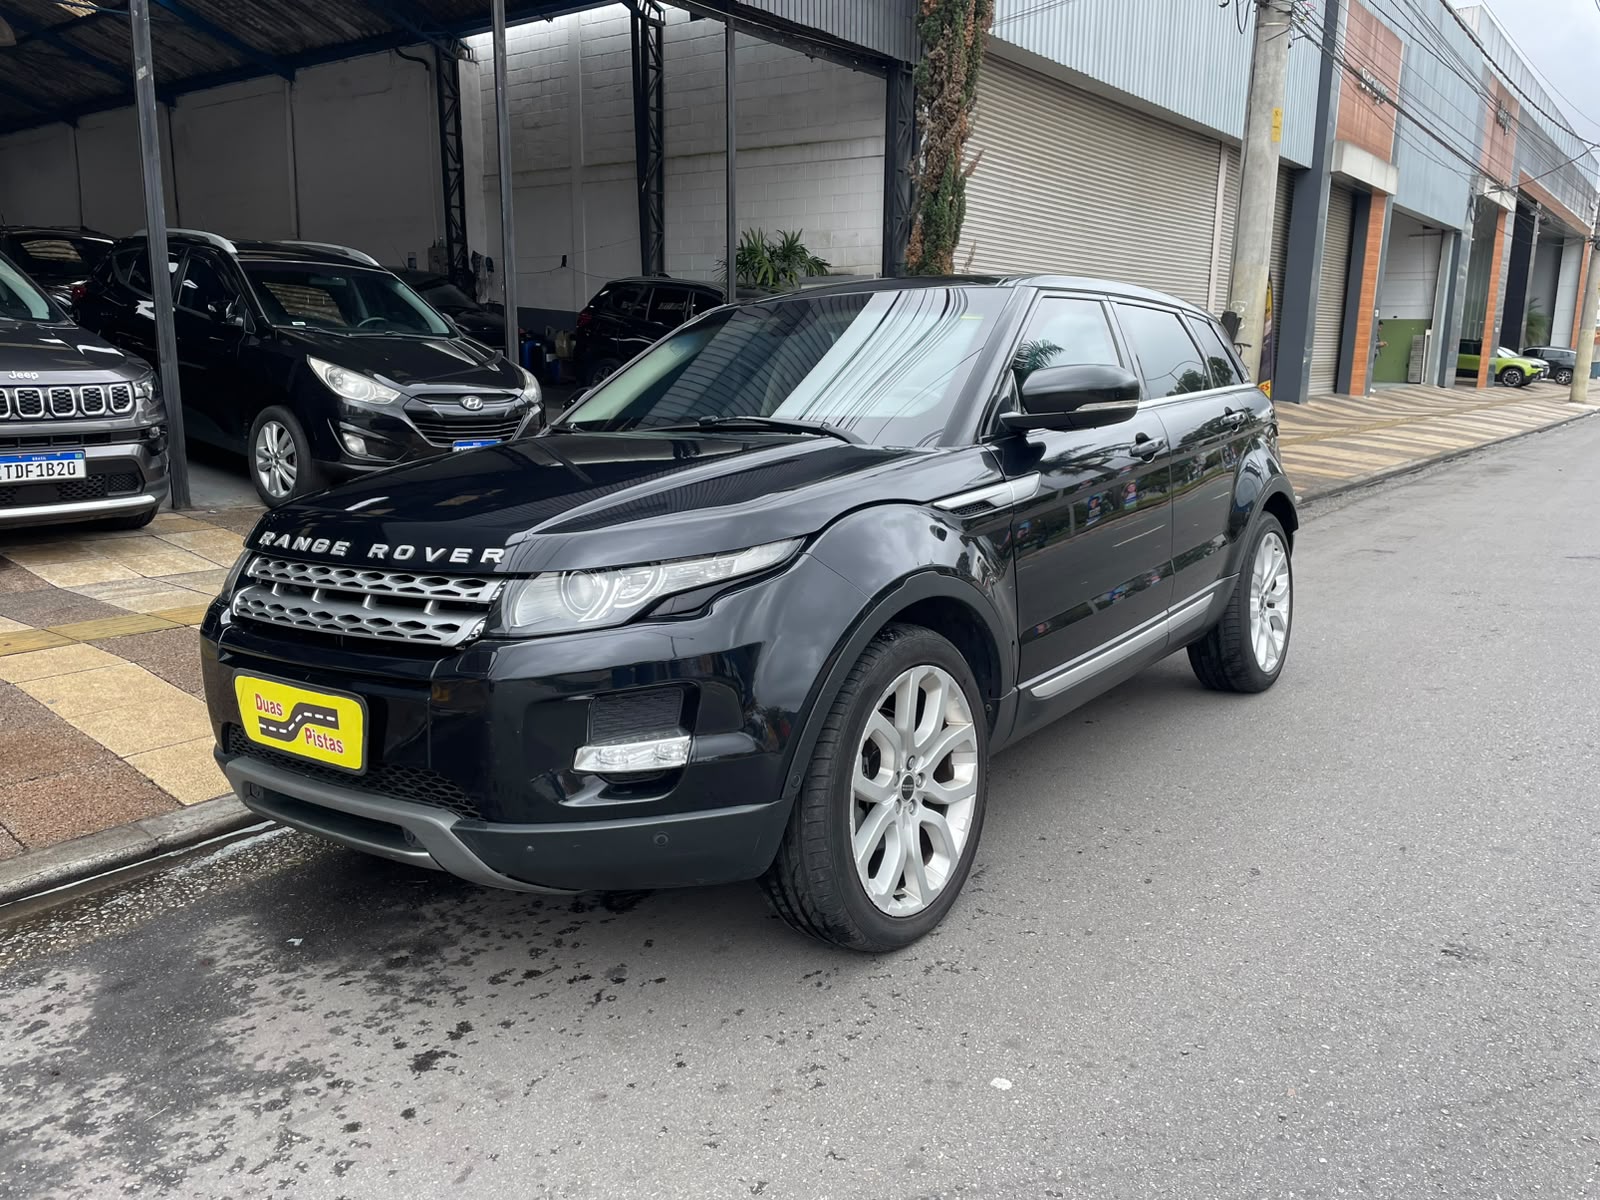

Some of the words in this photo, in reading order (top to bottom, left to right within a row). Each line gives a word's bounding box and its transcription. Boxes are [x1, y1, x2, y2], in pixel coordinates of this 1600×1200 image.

[8, 370, 39, 380] Jeep
[4, 461, 76, 479] TDF1B20
[258, 531, 351, 557] RANGE
[367, 543, 505, 564] ROVER
[255, 693, 283, 716] Duas
[304, 727, 344, 754] Pistas
